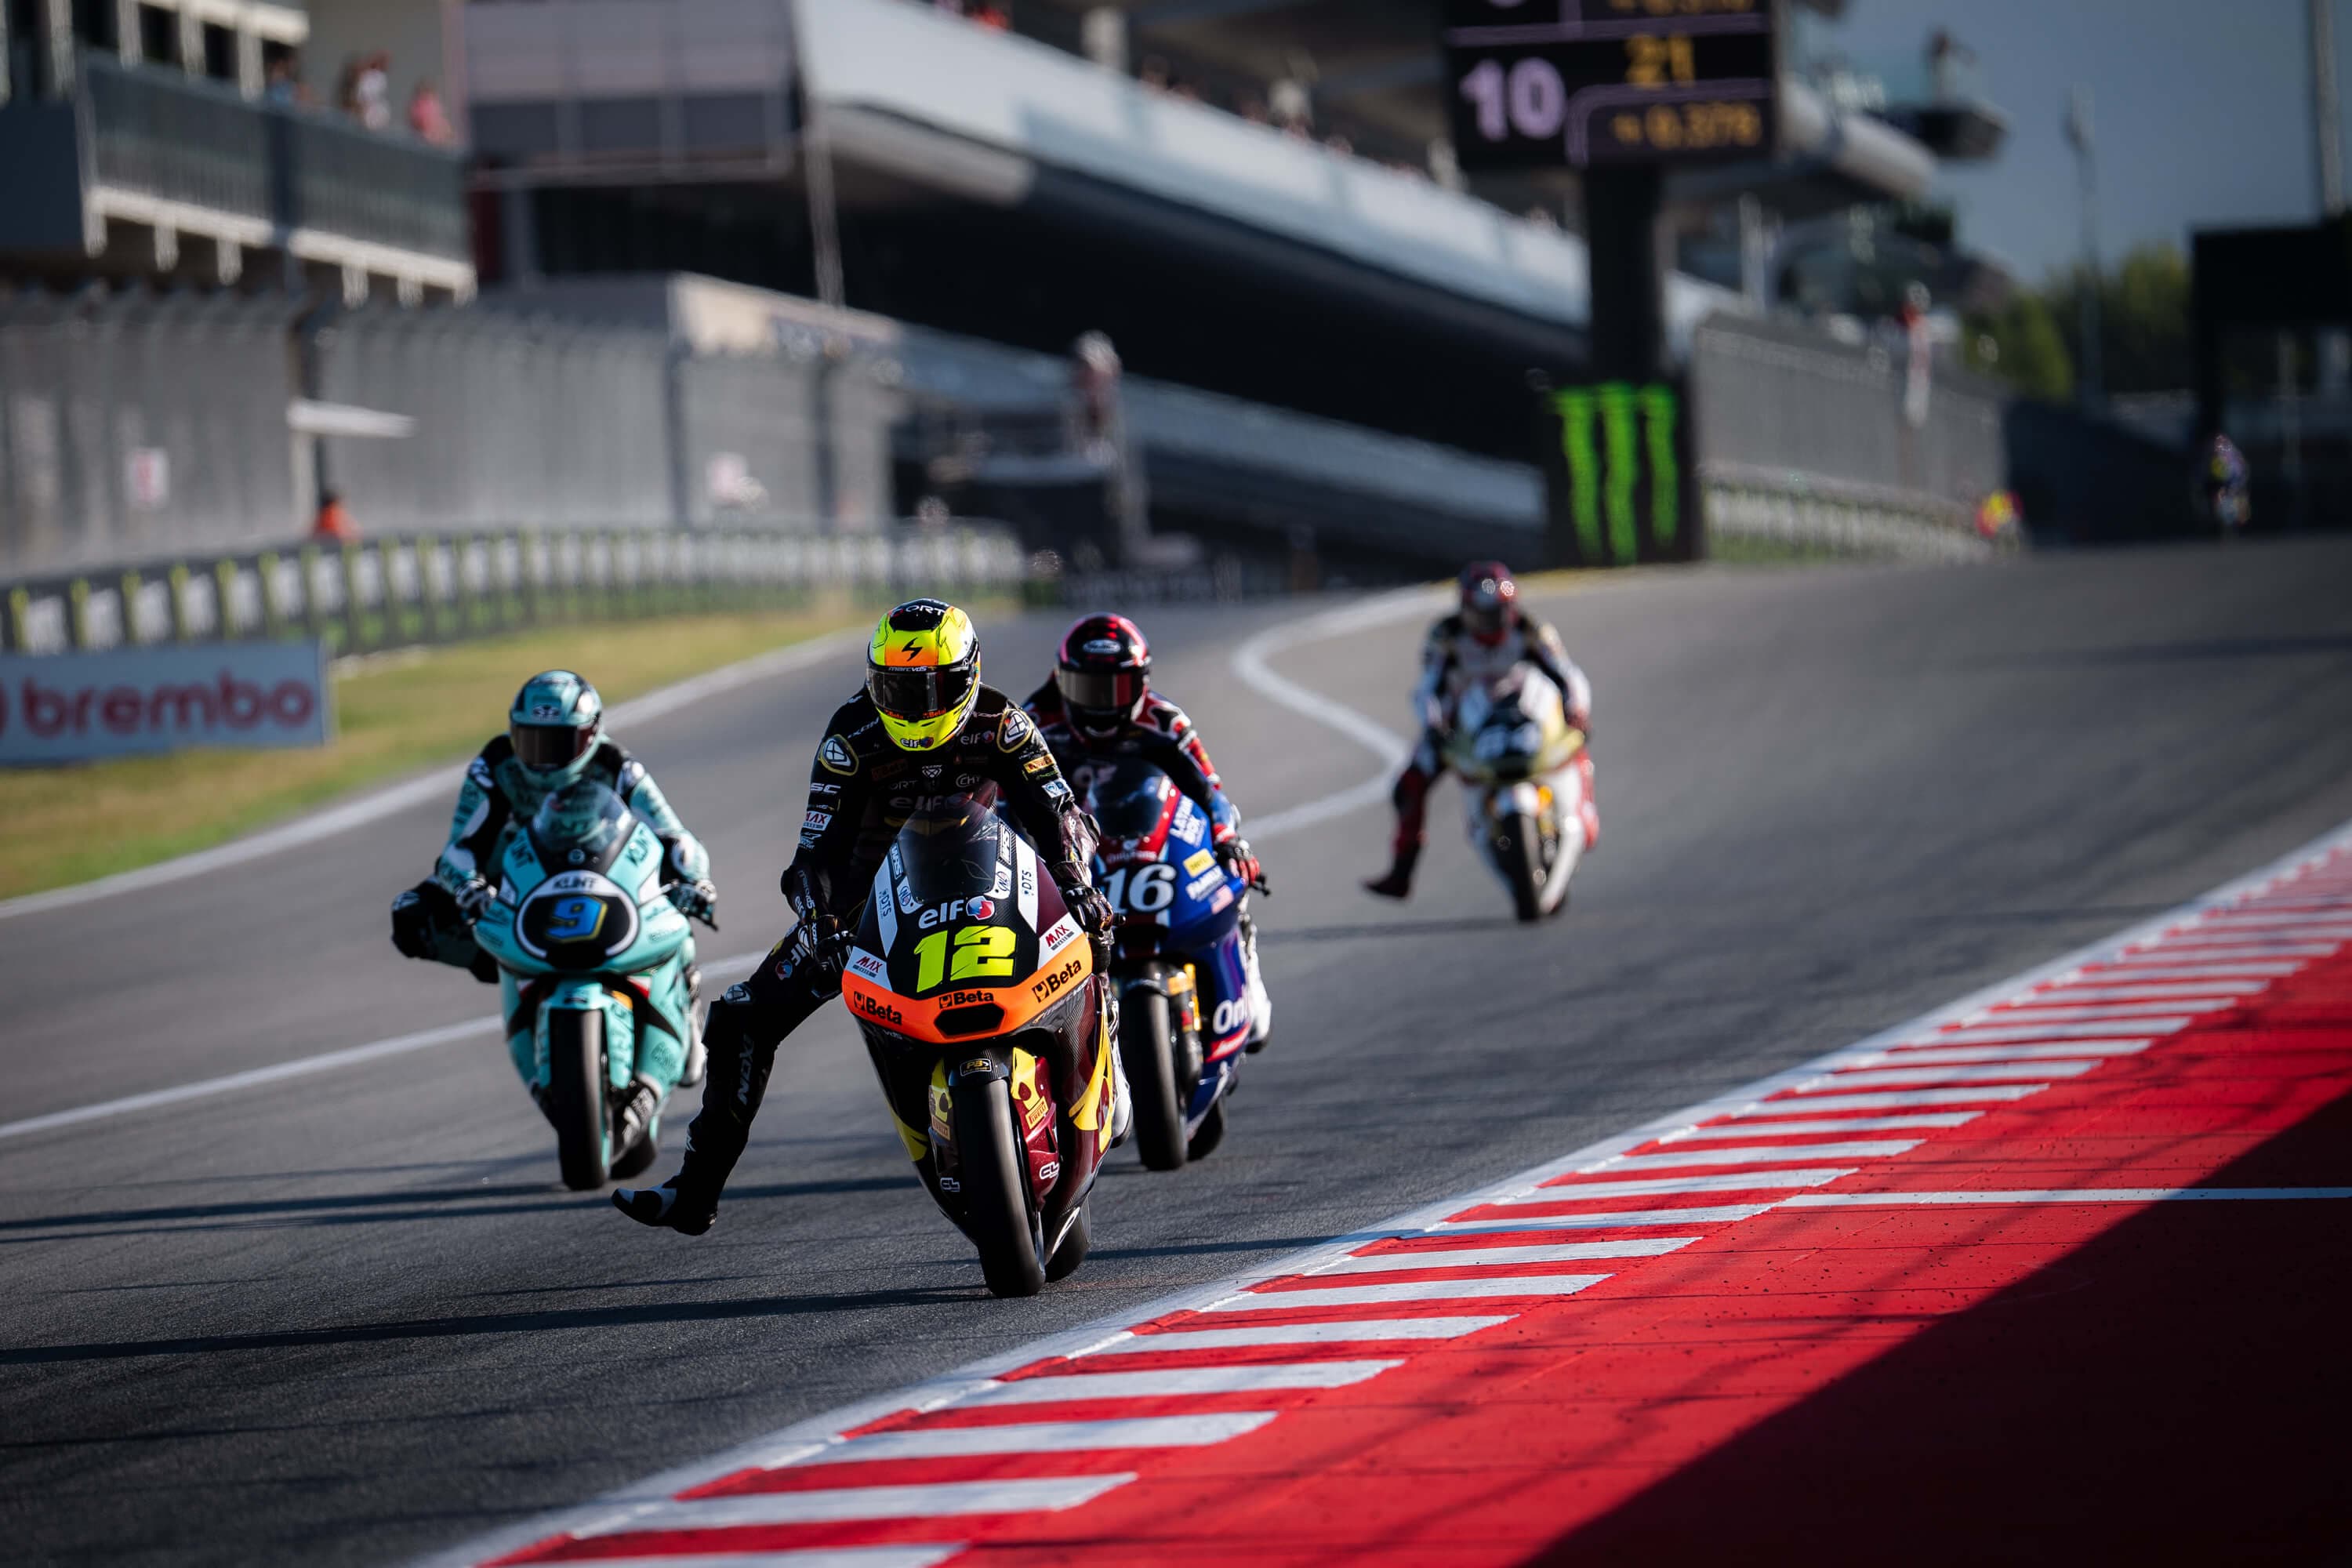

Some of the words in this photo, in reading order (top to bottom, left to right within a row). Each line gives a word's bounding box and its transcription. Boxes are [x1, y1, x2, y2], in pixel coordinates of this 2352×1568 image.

[1460, 57, 1566, 141] 10
[21, 667, 314, 739] brembo
[1022, 869, 1032, 891] DTS
[1102, 863, 1176, 914] 16
[546, 895, 608, 943] 9
[880, 894, 892, 917] DTS
[918, 899, 965, 929] elf
[1045, 924, 1071, 947] MAX
[855, 956, 883, 974] MAX
[913, 925, 1017, 993] 12
[1046, 958, 1083, 993] Beta
[866, 997, 902, 1025] Beta
[953, 990, 994, 1005] Beta
